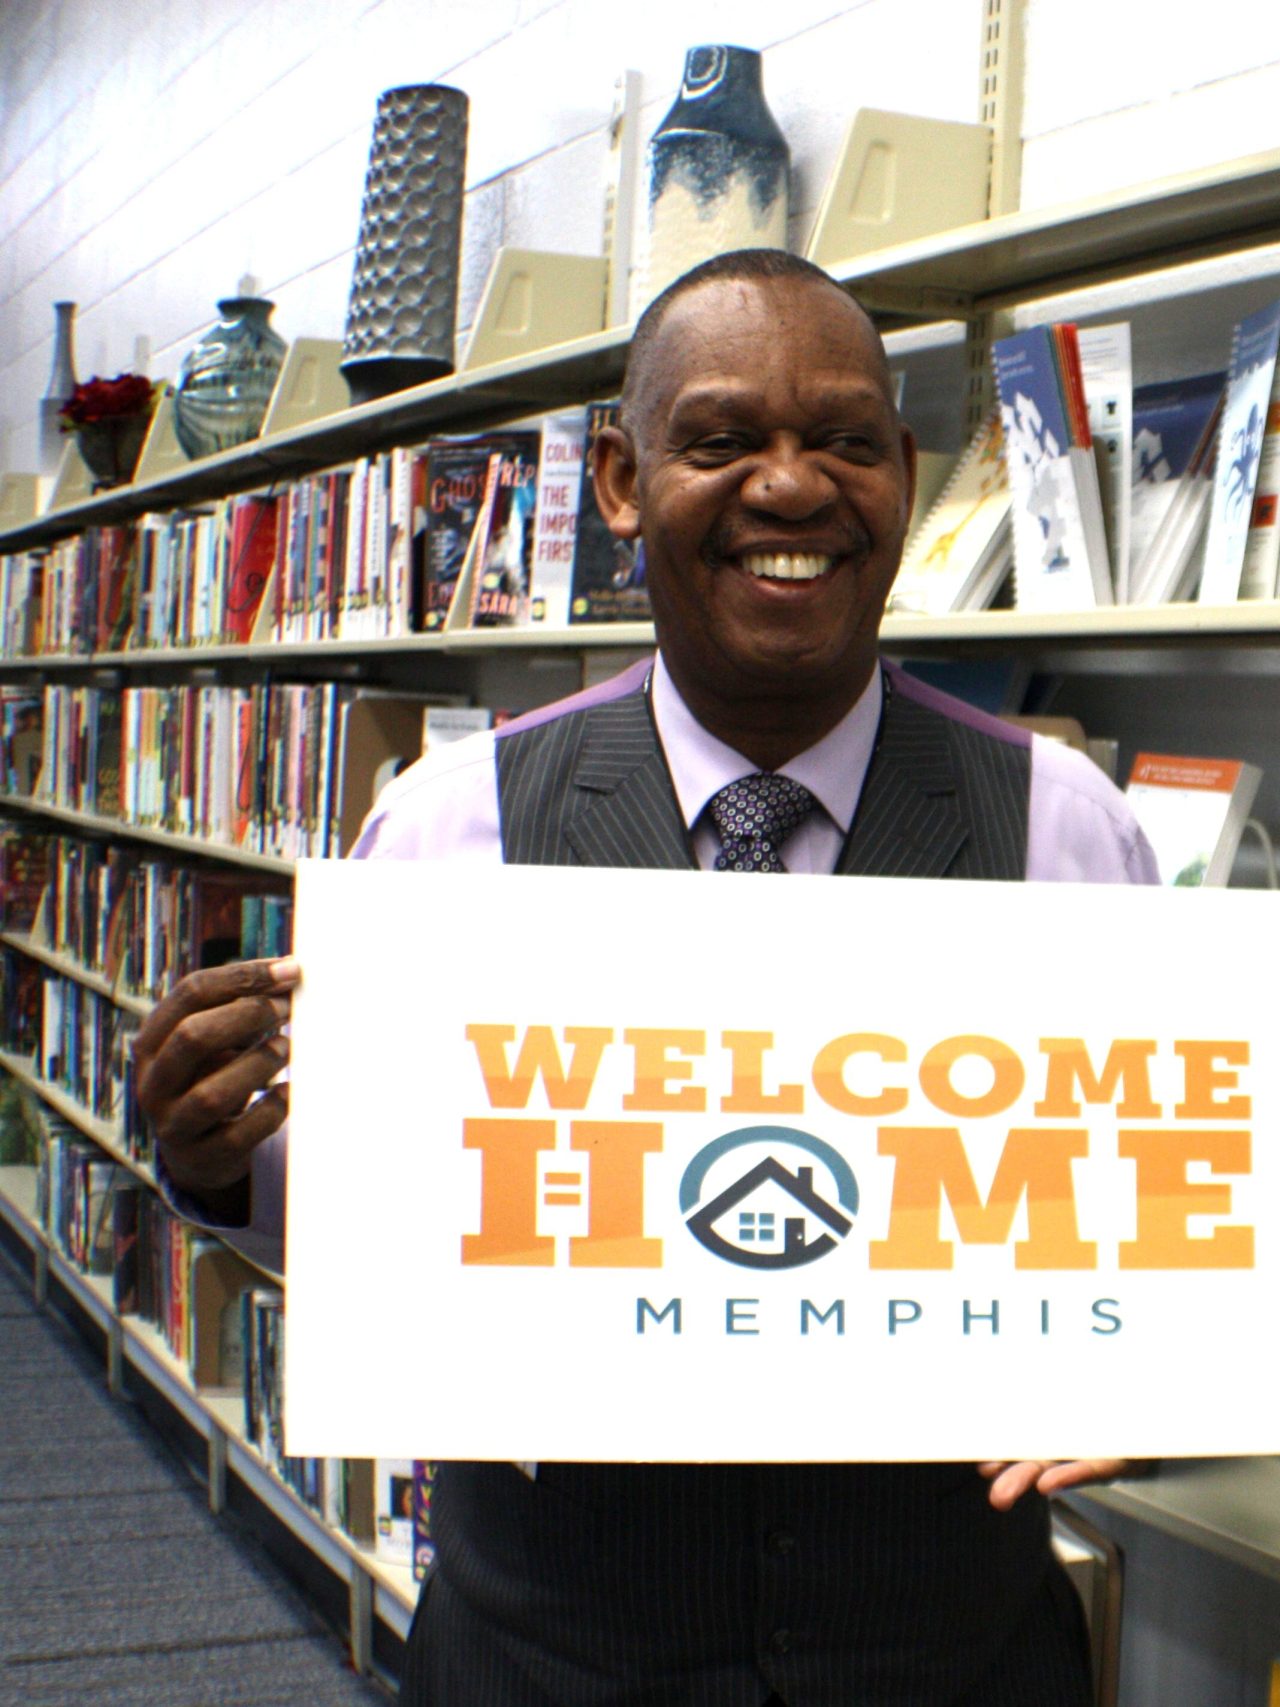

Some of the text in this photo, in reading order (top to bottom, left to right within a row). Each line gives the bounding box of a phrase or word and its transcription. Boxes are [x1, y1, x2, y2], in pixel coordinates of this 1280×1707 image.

[541, 485, 570, 507] THE
[479, 592, 518, 615] SARA
[464, 1023, 1253, 1120] WELCOME
[635, 1297, 1123, 1336] MEMPHIS
